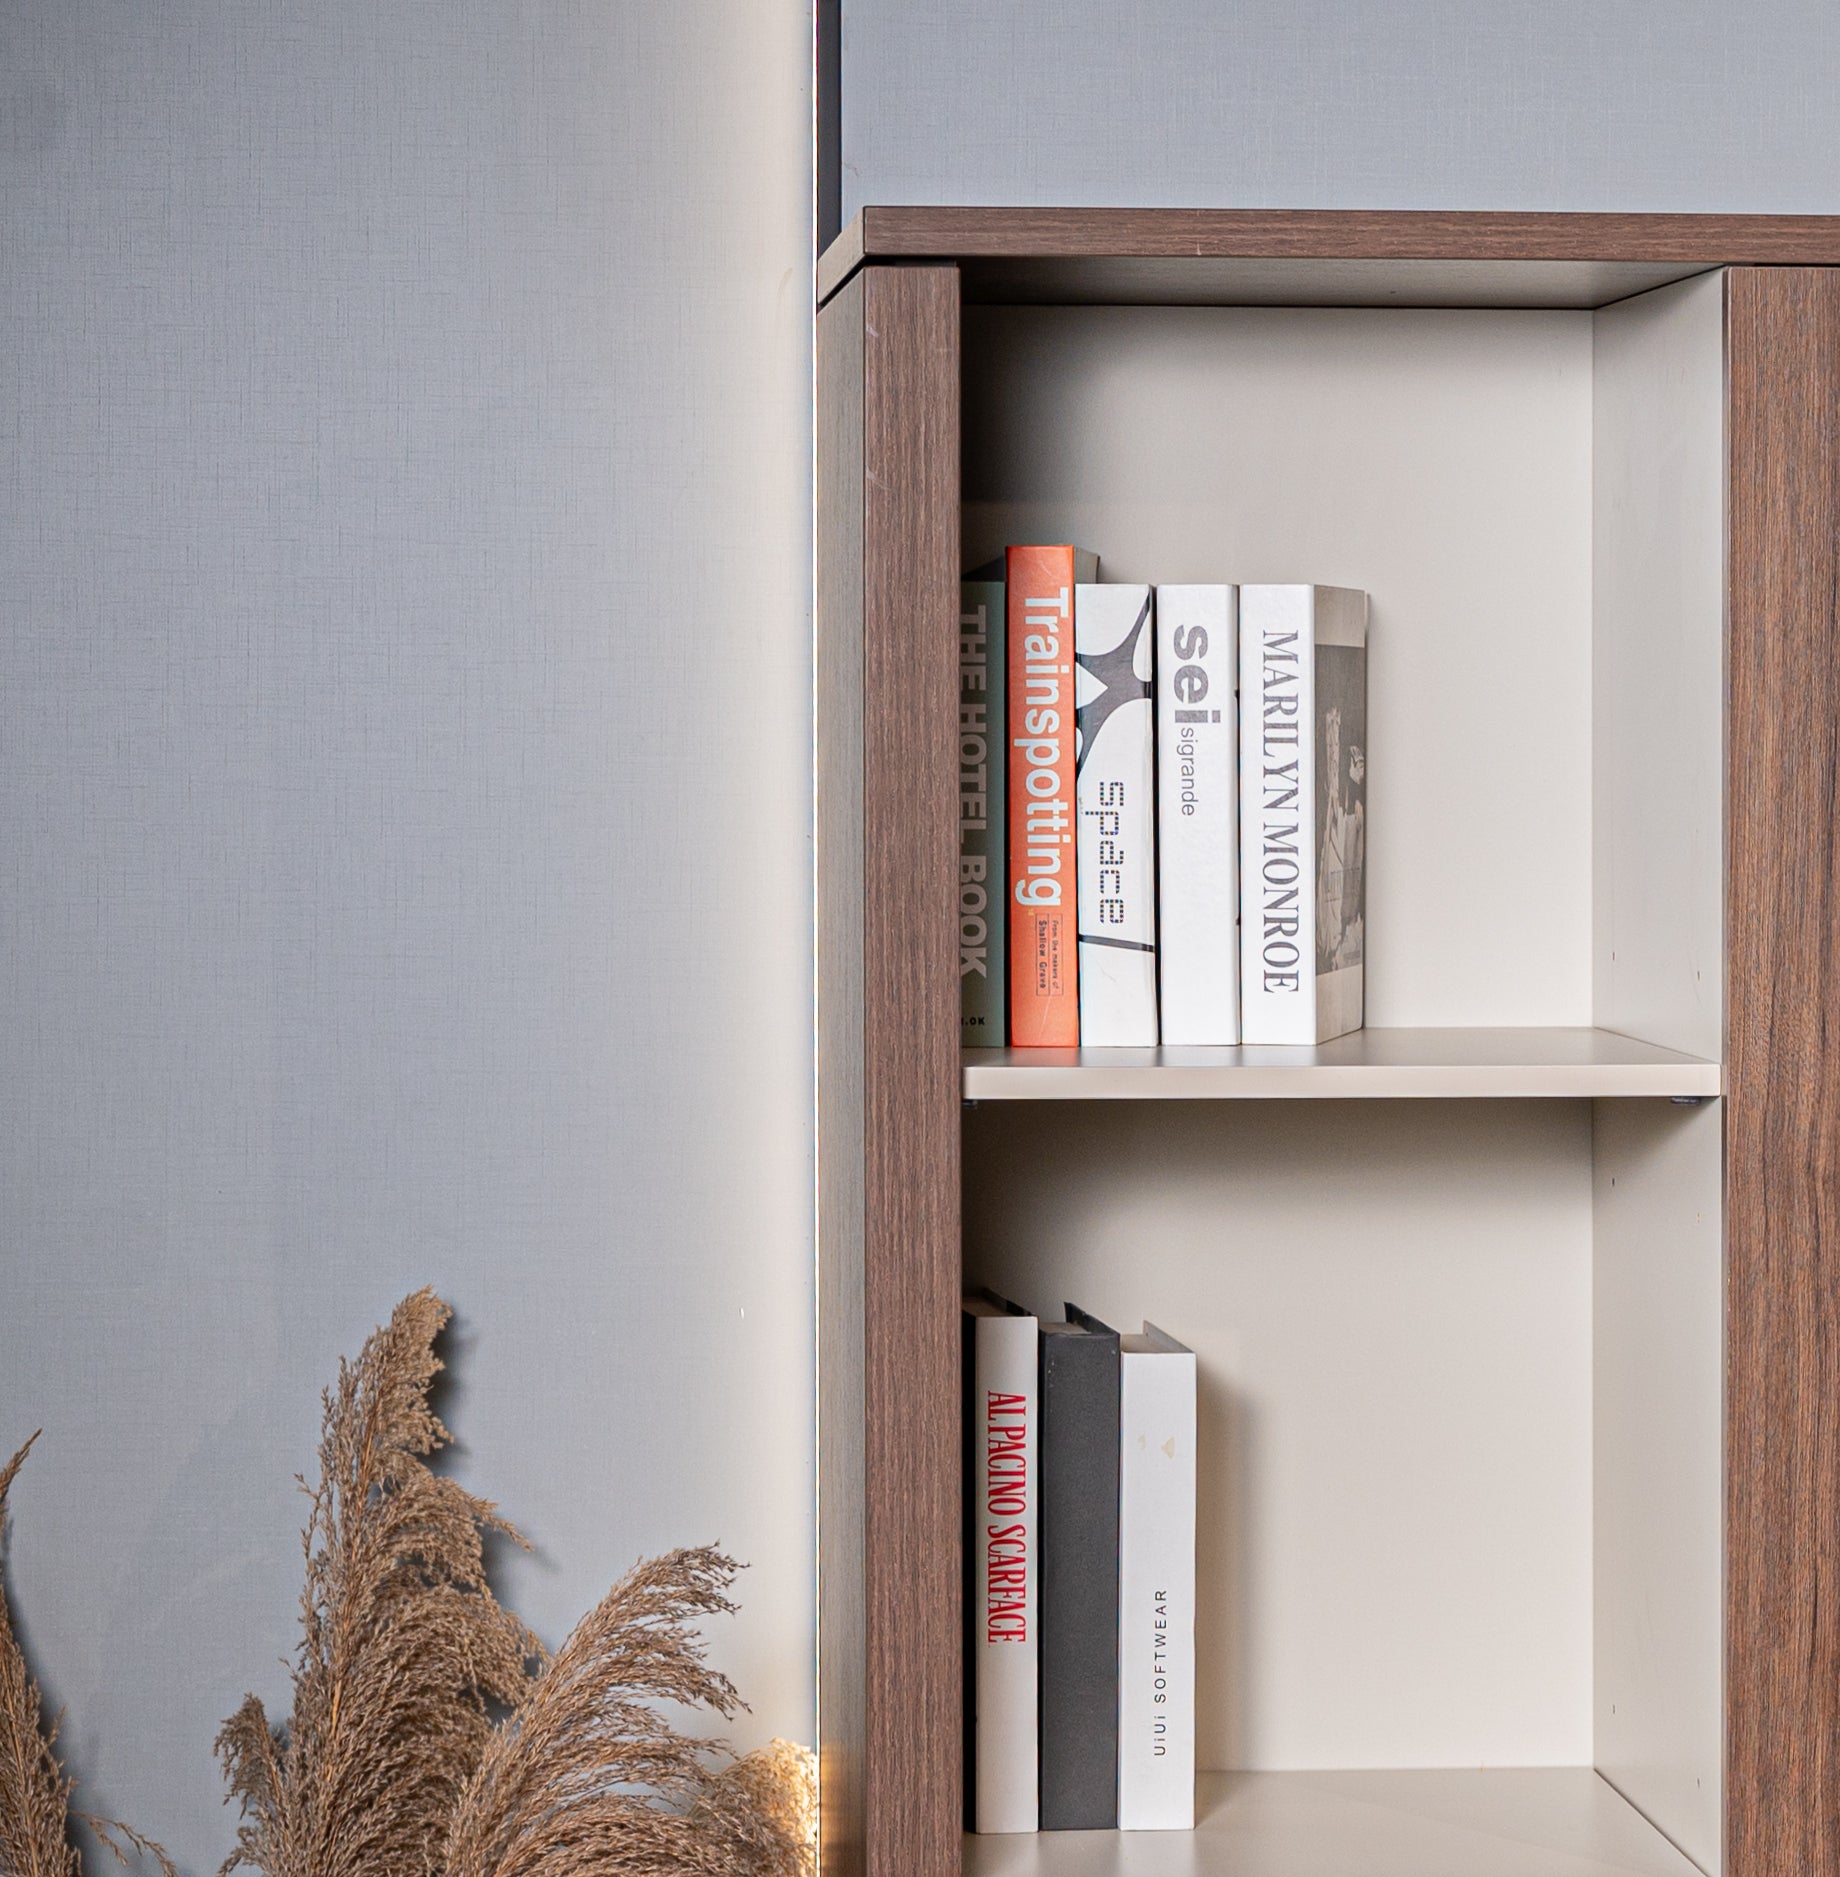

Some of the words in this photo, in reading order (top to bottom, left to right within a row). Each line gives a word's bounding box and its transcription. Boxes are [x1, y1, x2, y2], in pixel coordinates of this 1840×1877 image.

[959, 604, 987, 691] THE
[1173, 625, 1221, 724] sei
[1014, 586, 1071, 907] Trainspotting
[1177, 727, 1199, 816] sigrande
[1262, 629, 1300, 812] MARILYN
[1085, 781, 1124, 924] space
[1262, 822, 1300, 994] MONROE
[959, 855, 988, 979] BOOK
[987, 1390, 1027, 1421] AL
[987, 1423, 1027, 1516] PACINO
[987, 1524, 1027, 1644] SCARFACE
[1153, 1590, 1168, 1704] SOFTWEAR
